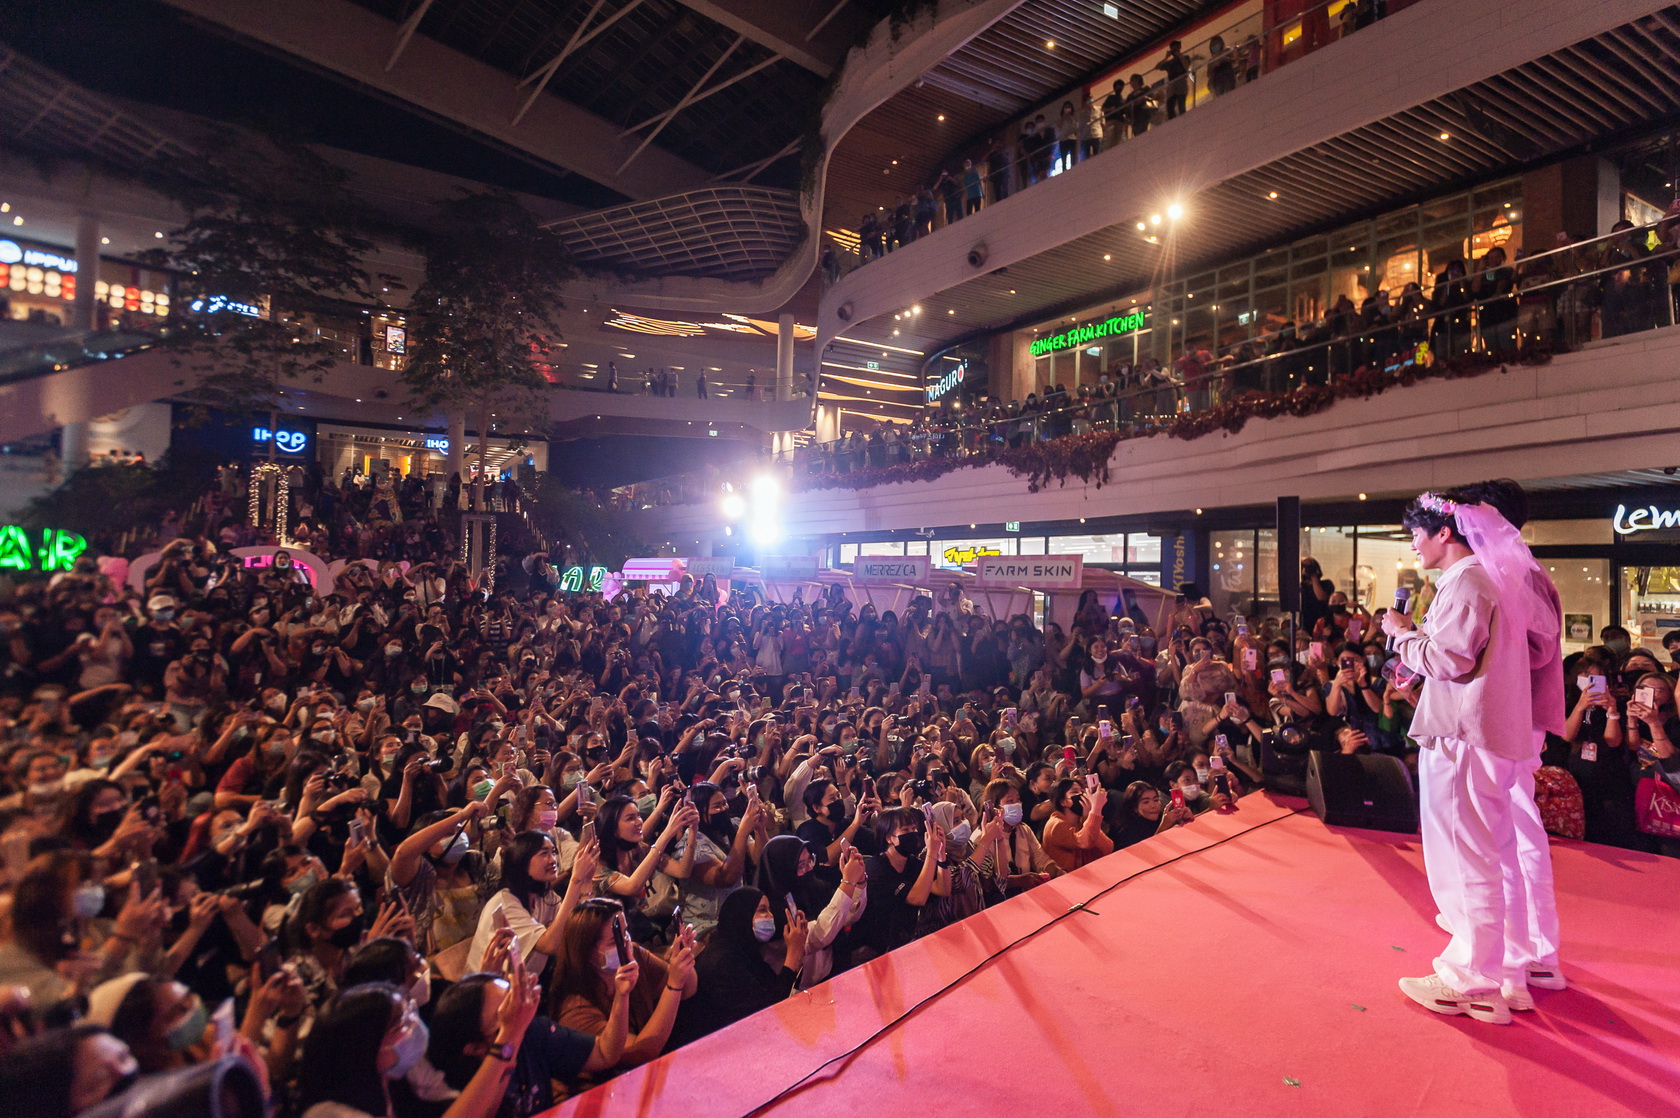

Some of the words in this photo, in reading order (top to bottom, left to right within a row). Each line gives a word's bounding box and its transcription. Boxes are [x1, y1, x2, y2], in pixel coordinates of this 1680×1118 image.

[1029, 334, 1067, 355] GINGER
[1067, 325, 1095, 347] FARM
[1096, 311, 1145, 338] KITCHEN
[928, 364, 965, 403] MAGURO
[427, 439, 449, 448] IHO
[985, 565, 1028, 576] FARM
[1033, 565, 1072, 577] SKIN
